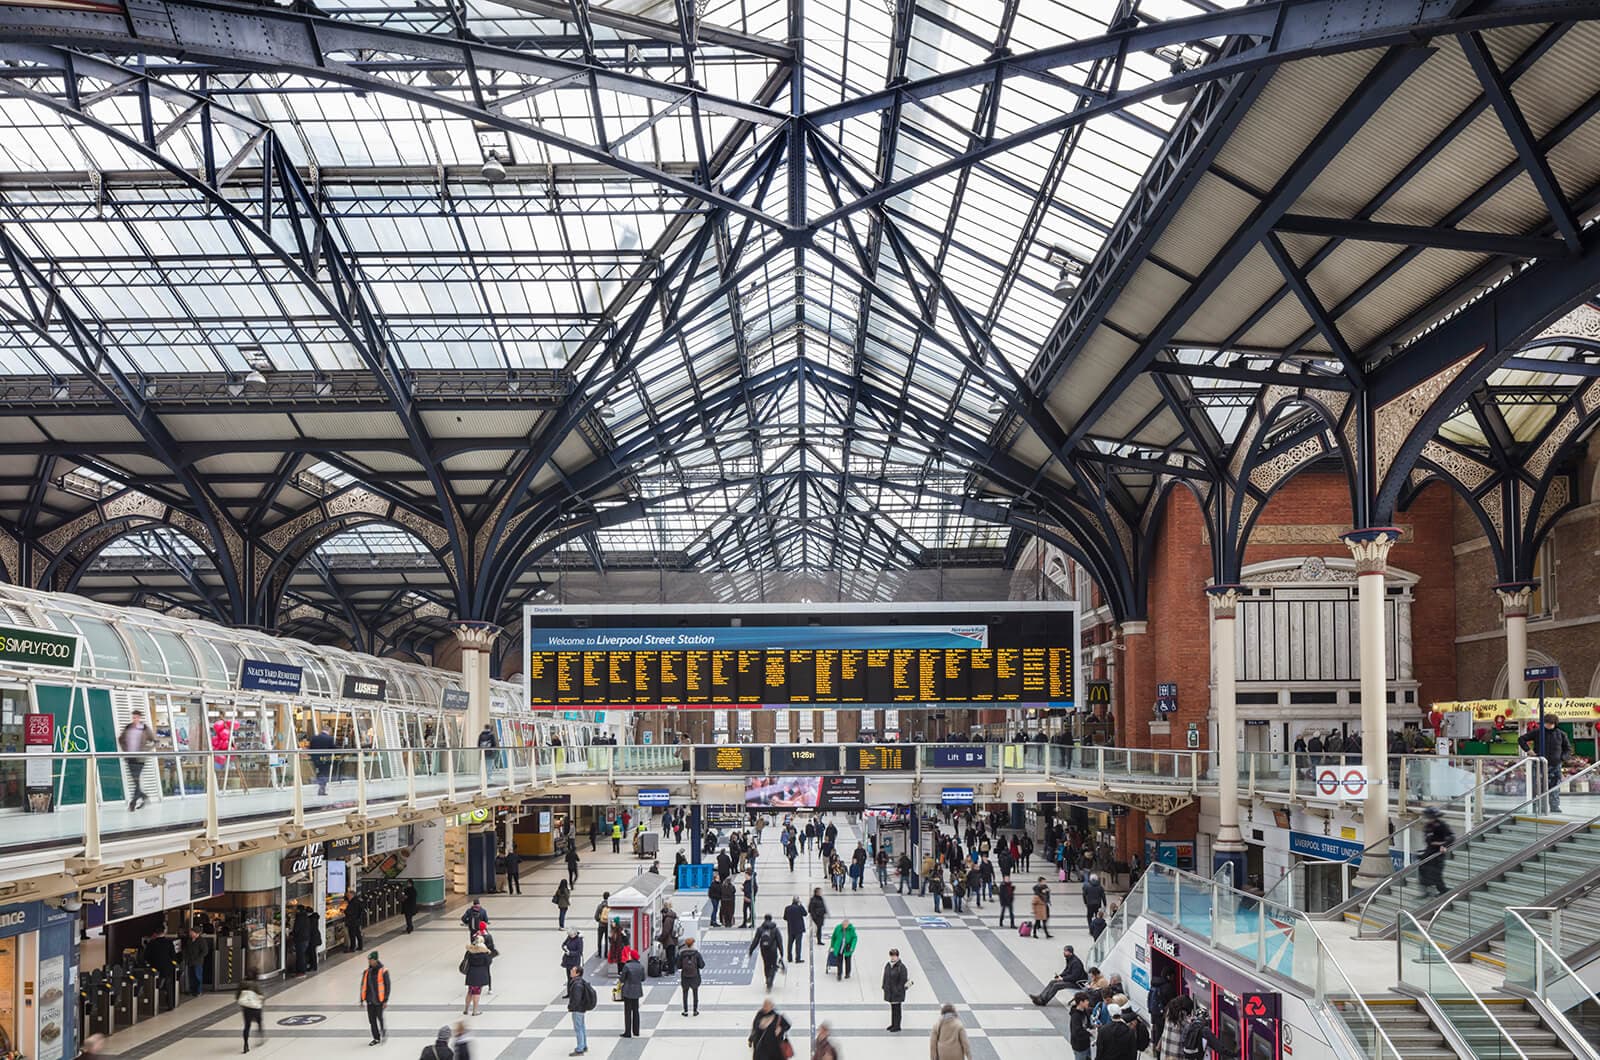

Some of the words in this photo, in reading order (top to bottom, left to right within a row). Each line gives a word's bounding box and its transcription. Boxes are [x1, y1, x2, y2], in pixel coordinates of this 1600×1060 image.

[6, 637, 41, 655] SIMPLY
[40, 642, 70, 658] FOOD
[549, 636, 585, 645] Welcome
[586, 636, 595, 645] to
[597, 635, 643, 648] Liverpool
[644, 634, 676, 645] Street
[678, 634, 715, 645] Station
[30, 725, 49, 735] £20
[947, 753, 959, 761] Lift
[1294, 838, 1320, 851] LIVERPOOL
[1321, 843, 1339, 855] STREET
[215, 861, 222, 879] 5
[1153, 932, 1175, 956] NatWest
